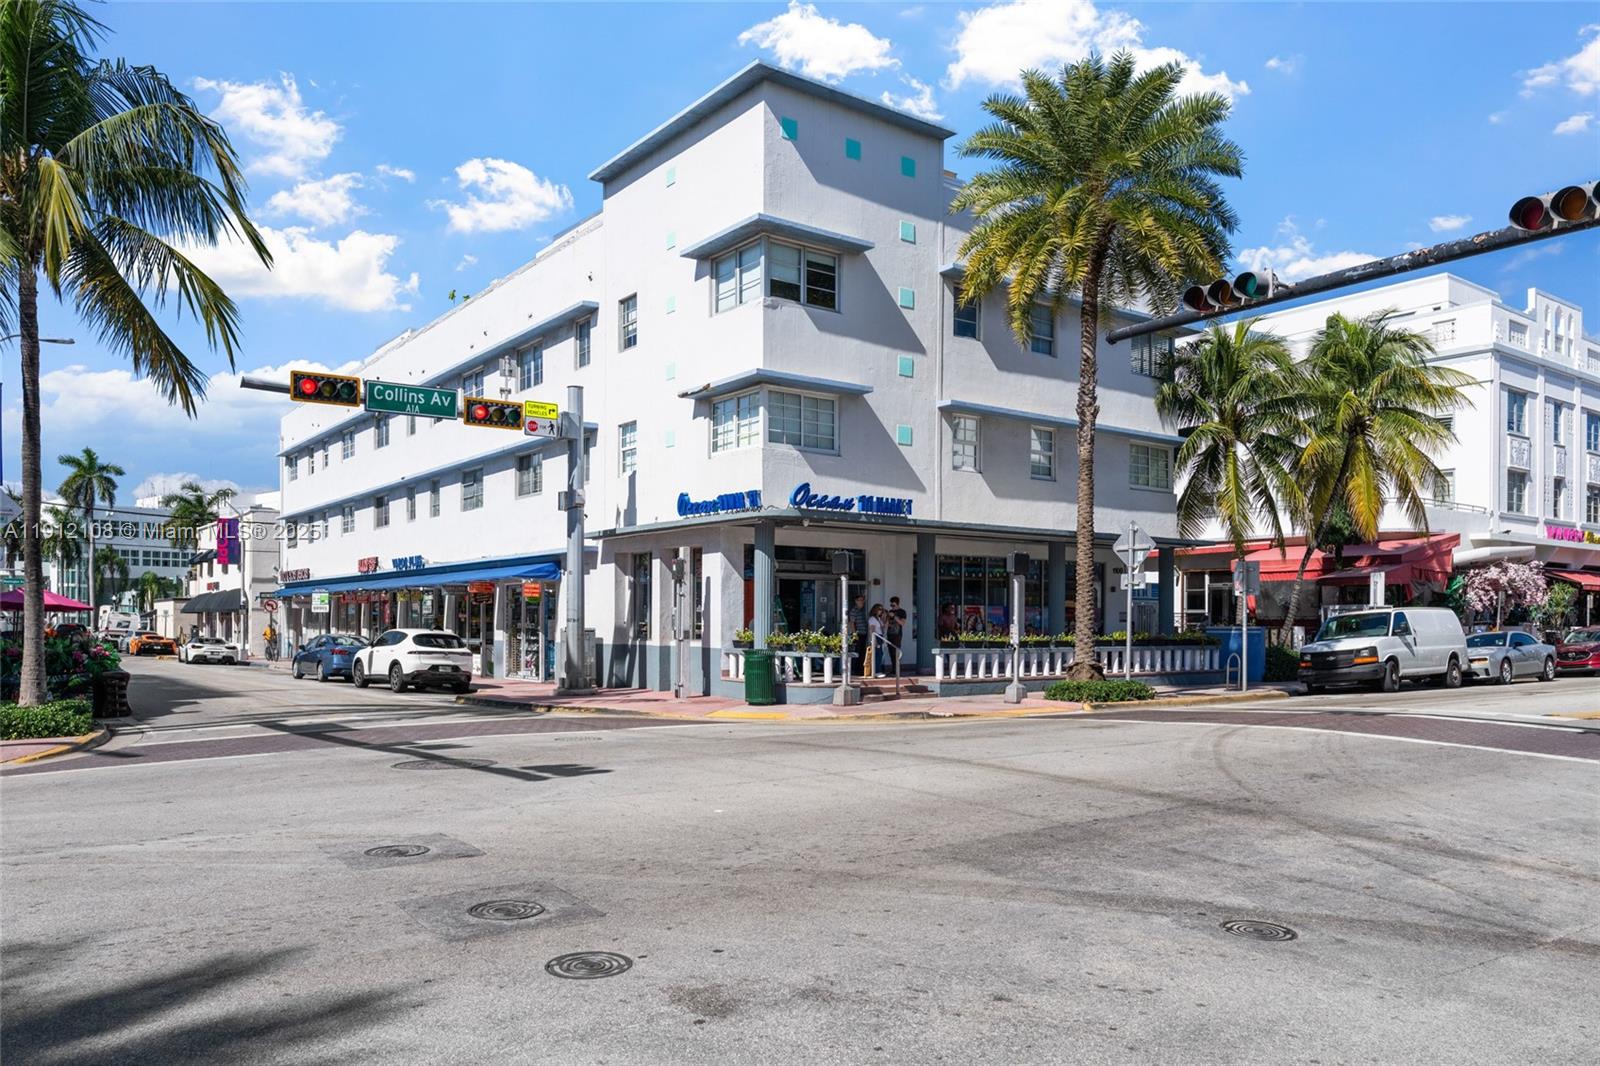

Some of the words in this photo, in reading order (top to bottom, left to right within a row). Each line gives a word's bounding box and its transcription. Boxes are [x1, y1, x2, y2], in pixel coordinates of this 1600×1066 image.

[373, 385, 425, 404] Collins
[430, 392, 452, 407] Av
[405, 404, 420, 413] A1A
[789, 482, 855, 511] Ocean
